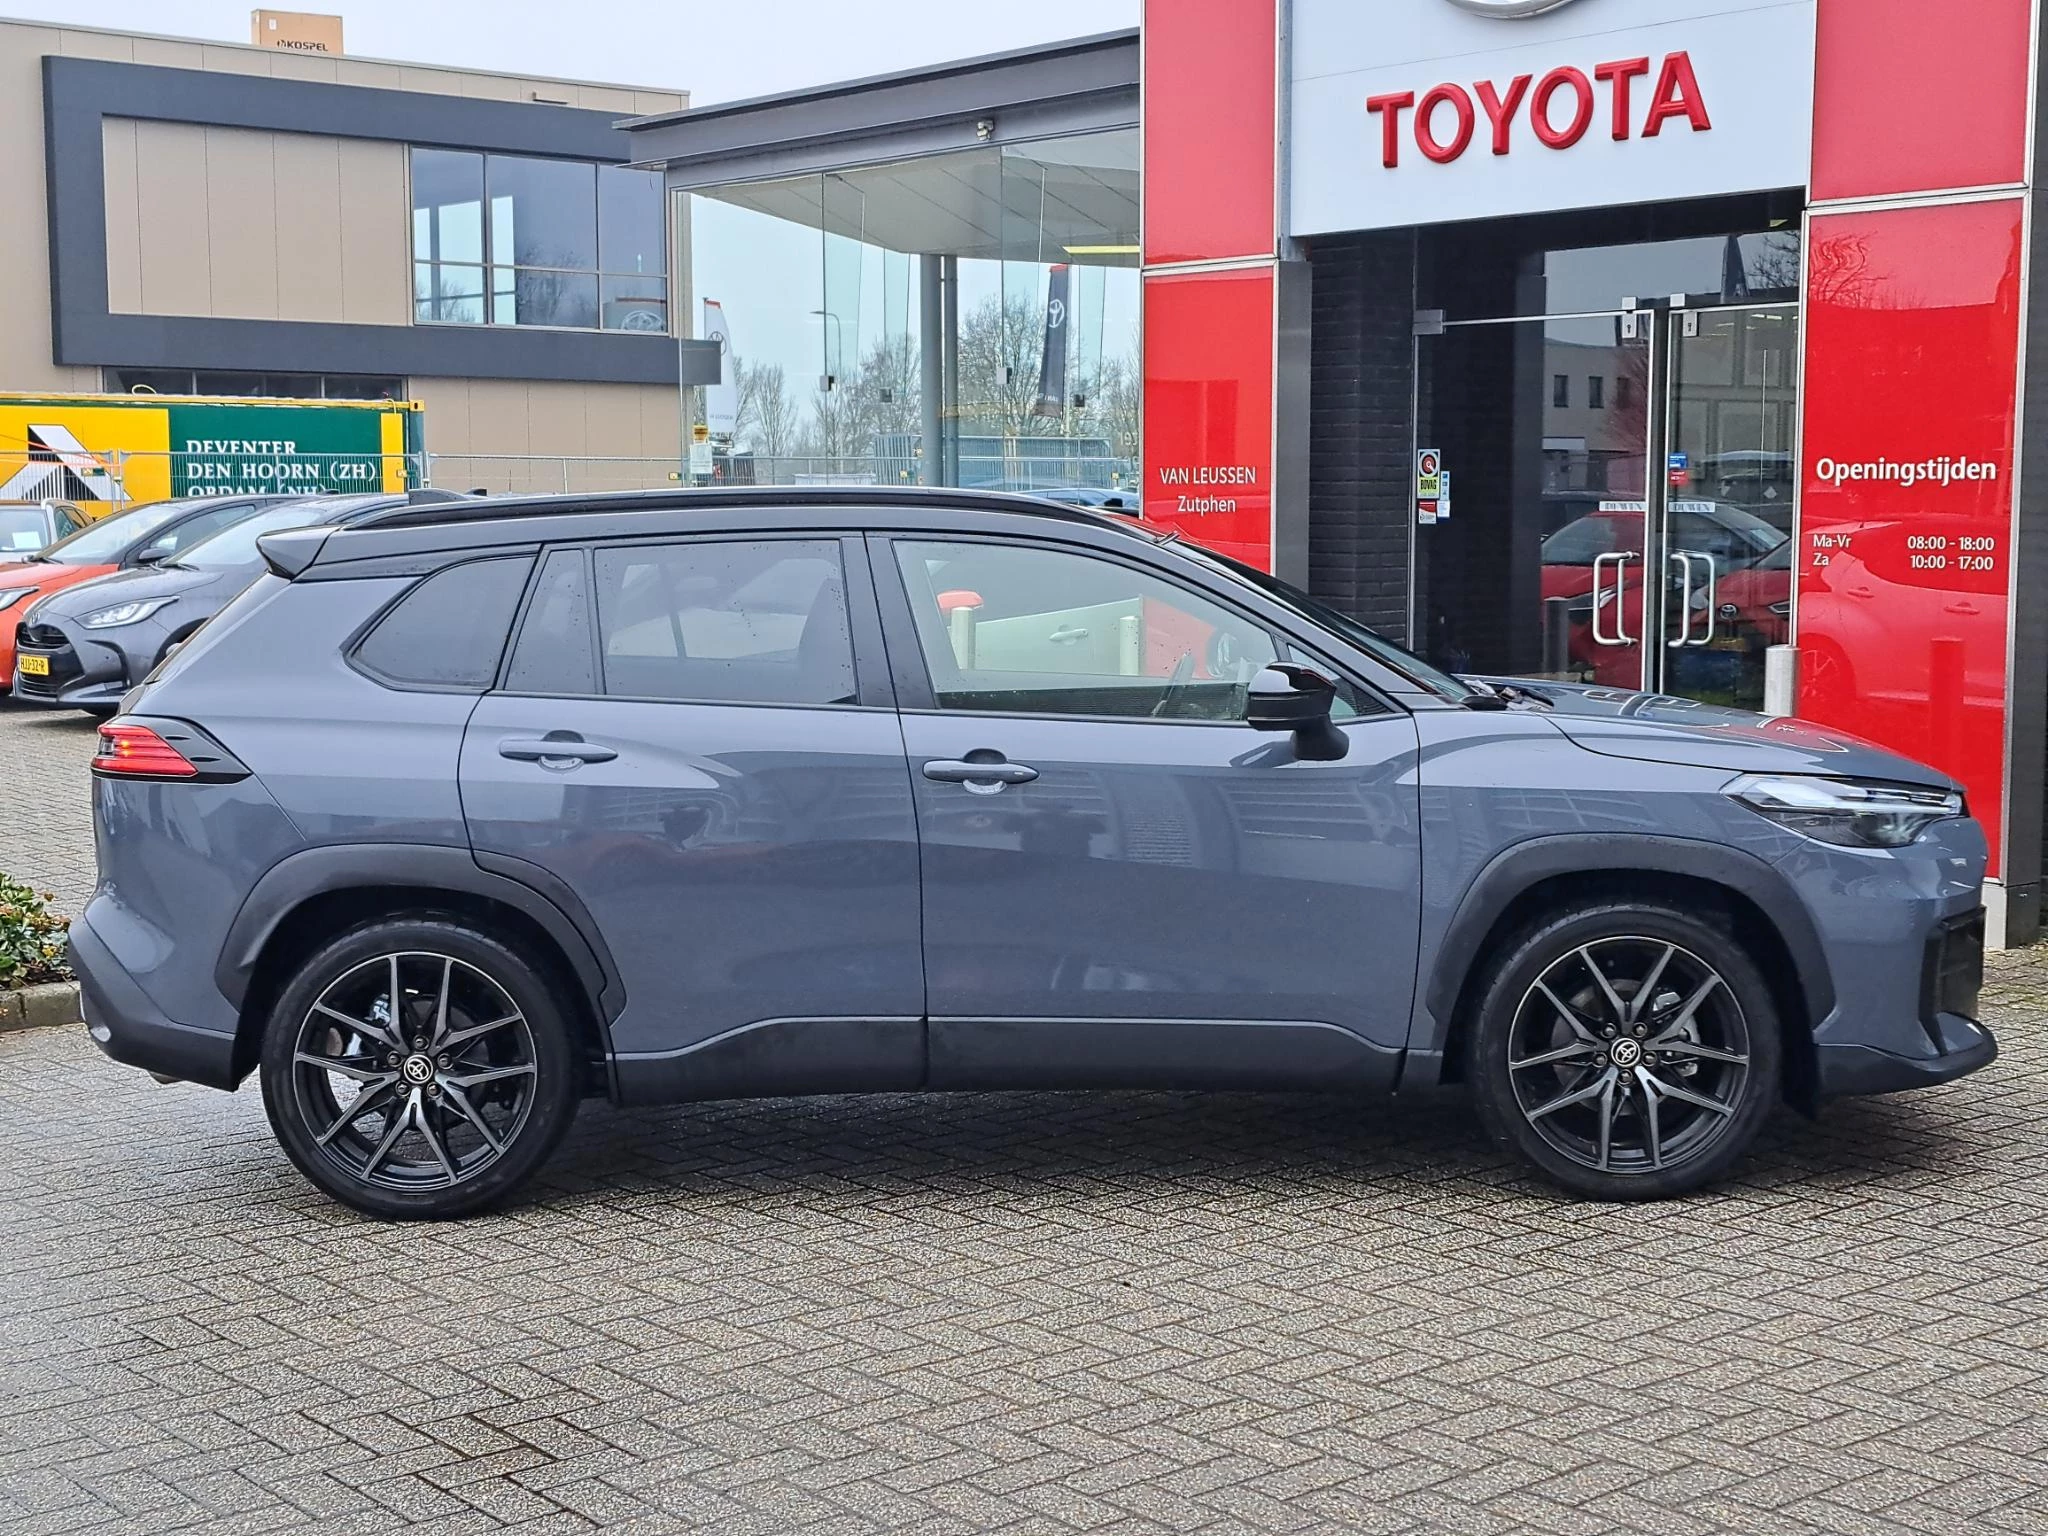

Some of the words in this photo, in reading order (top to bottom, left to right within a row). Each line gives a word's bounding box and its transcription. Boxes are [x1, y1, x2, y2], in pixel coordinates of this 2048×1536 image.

[286, 40, 329, 52] KOSPEL
[1366, 50, 1712, 169] TOYOTA
[186, 439, 297, 455] DEVENTER
[187, 463, 232, 480] DEN
[241, 463, 320, 480] HOORN
[330, 461, 376, 482] (ZH)
[1159, 466, 1189, 485] VAN
[1193, 466, 1256, 485] LEUSSEN
[1816, 456, 1996, 487] Openingstijden
[1177, 494, 1236, 517] Zutphen
[1812, 534, 1852, 548] Ma-Vr
[1907, 535, 1946, 550] 08:00
[1958, 536, 1995, 551] 18:00
[1812, 552, 1830, 566] Za
[1910, 555, 1946, 569] 10:00
[1957, 556, 1994, 570] 17:00
